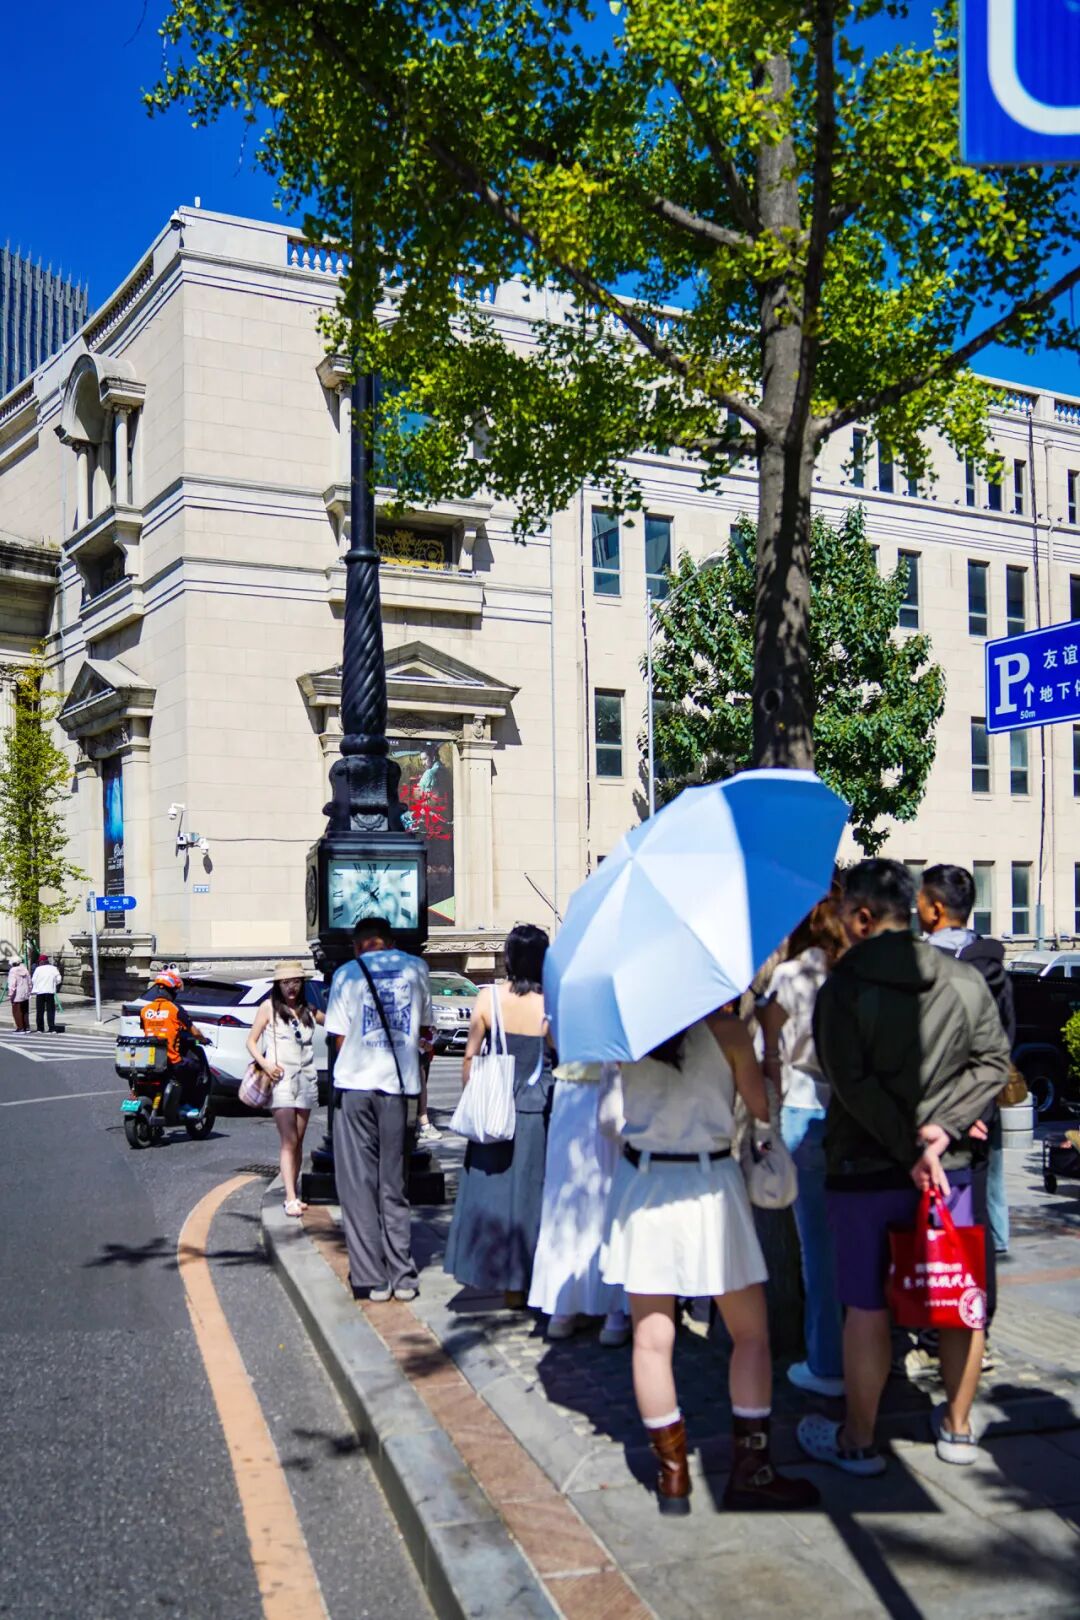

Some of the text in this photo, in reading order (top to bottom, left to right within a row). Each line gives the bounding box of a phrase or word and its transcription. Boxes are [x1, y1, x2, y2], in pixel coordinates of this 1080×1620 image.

[1043, 644, 1079, 670] 友谊
[994, 652, 1031, 715] P
[1020, 709, 1036, 720] 50m
